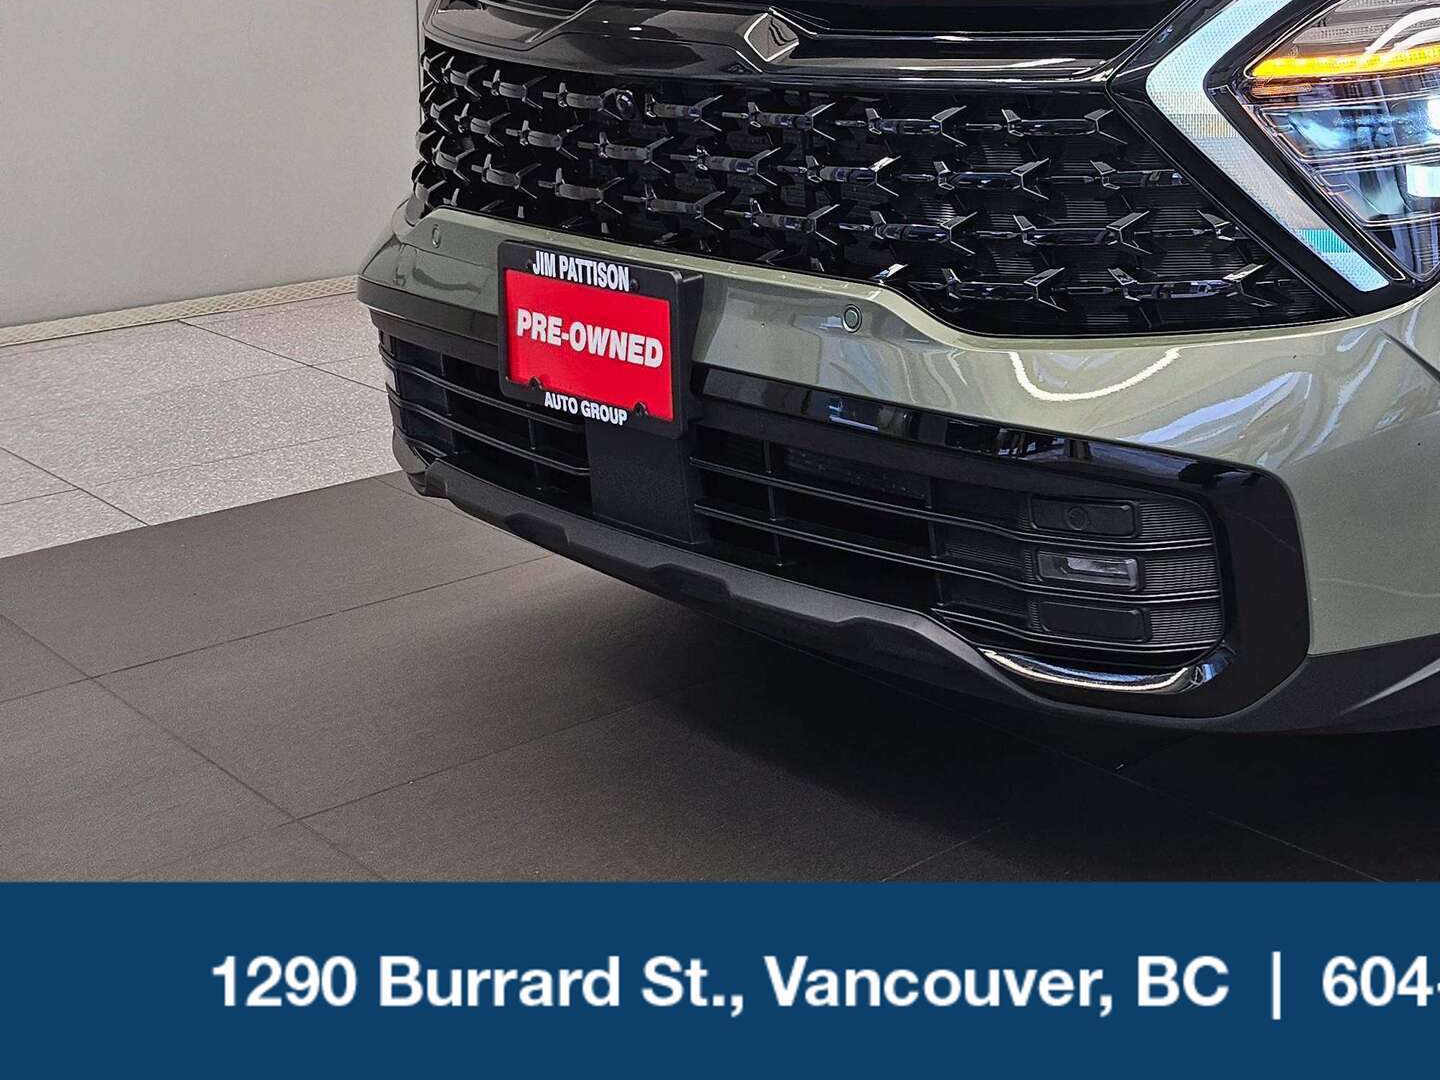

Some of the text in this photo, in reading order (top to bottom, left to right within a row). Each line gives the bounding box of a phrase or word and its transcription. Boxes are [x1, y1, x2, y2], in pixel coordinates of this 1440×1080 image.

[533, 250, 630, 292] JIM PATTISON
[516, 308, 664, 368] PRE-OWNED
[544, 391, 628, 426] AUTO GROUP
